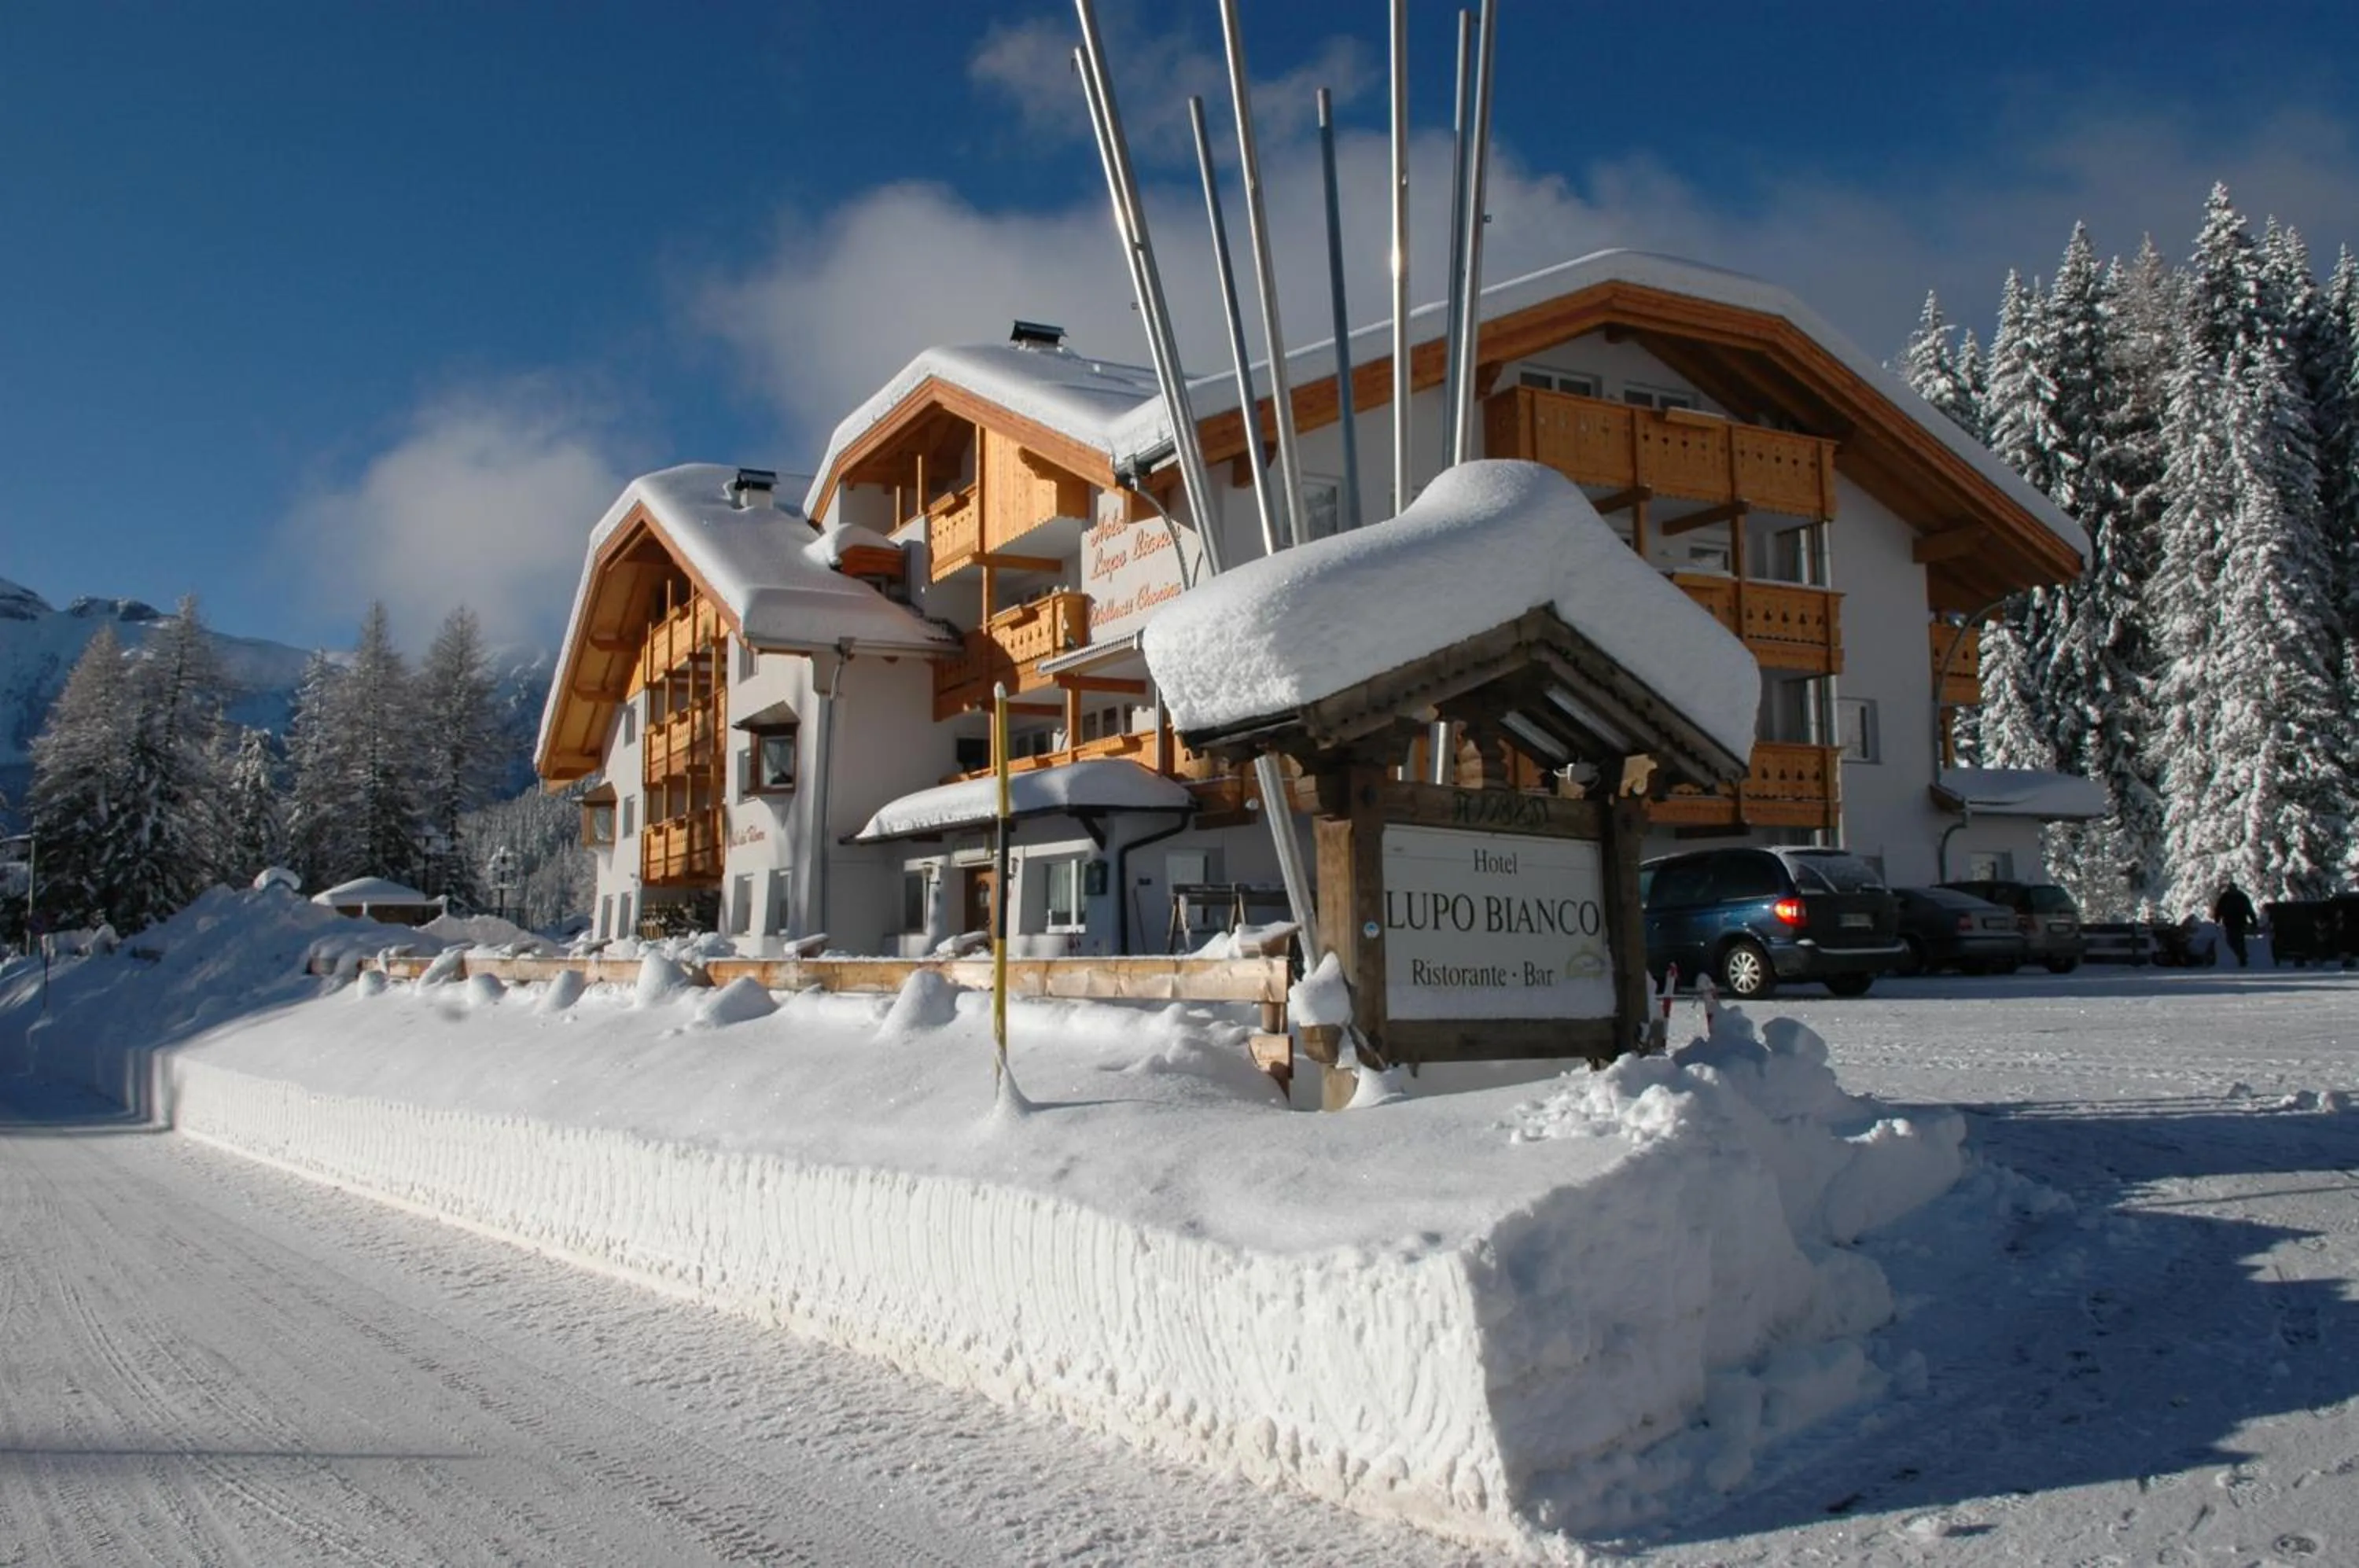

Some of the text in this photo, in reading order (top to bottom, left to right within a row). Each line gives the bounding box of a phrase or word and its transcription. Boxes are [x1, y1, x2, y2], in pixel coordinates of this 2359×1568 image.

[1090, 547, 1126, 583] Lupo
[1474, 848, 1518, 874] Hotel
[1386, 891, 1600, 937] LUPO BIANCO
[1412, 959, 1555, 988] Ristorante Bar
